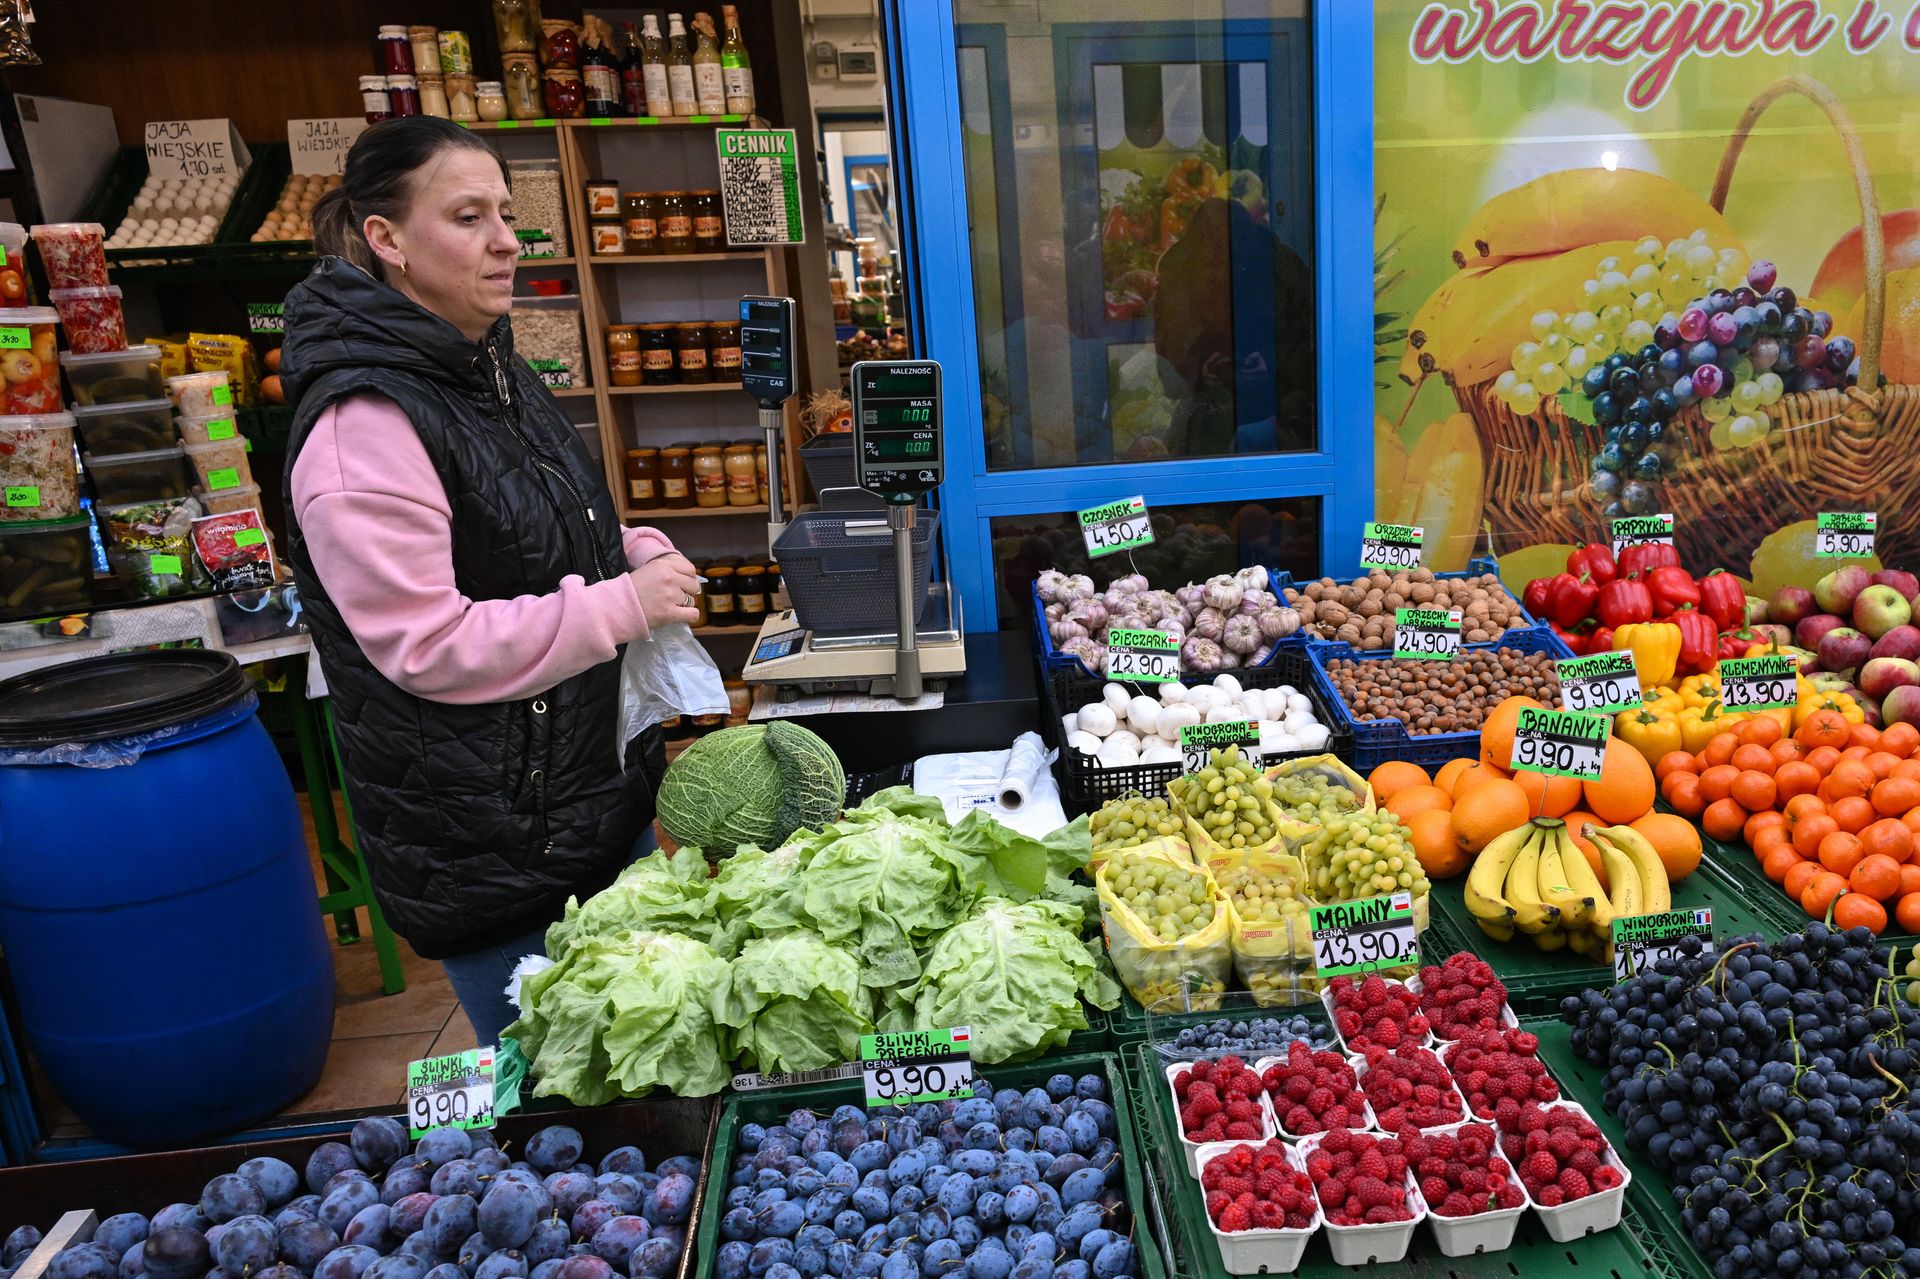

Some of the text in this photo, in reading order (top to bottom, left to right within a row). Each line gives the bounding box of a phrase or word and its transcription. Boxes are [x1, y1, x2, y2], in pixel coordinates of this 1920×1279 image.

[1409, 0, 1838, 111] warzywa
[148, 122, 192, 139] JAJA
[305, 121, 339, 137] JAJA
[146, 142, 224, 160] WIEJSKIE
[298, 137, 351, 152] WIEJSKIE
[726, 135, 787, 154] CENNIK
[769, 379, 784, 387] CAS
[913, 432, 933, 440] CENA
[1082, 503, 1132, 523] CZOSNEK
[1830, 513, 1862, 523] JABŁKA
[1093, 522, 1134, 548] 4.50
[1374, 524, 1415, 538] ORZECHY
[1614, 518, 1666, 535] PAPRYKA
[1824, 535, 1860, 554] 5.90
[1364, 544, 1411, 567] 29.90
[1407, 609, 1449, 621] ORZECHY
[1399, 631, 1448, 654] 24.90
[1112, 654, 1163, 676] 12.90
[1562, 677, 1589, 687] CENA:
[1723, 677, 1749, 685] CENA:
[1570, 680, 1621, 712] 9.90
[1724, 681, 1785, 707] 13.90
[1522, 709, 1597, 739] BANANY
[1189, 731, 1253, 745] RODZYNKOWE
[1518, 729, 1548, 740] CNA:
[1183, 744, 1210, 752] CENA:
[1519, 738, 1574, 771] 9.90
[1315, 927, 1349, 939] CENA:
[1320, 932, 1400, 968] 13.90
[875, 1042, 951, 1061] PRECENTA
[865, 1059, 900, 1069] CENA:
[412, 1074, 430, 1087] TOP
[875, 1066, 946, 1099] 9.90
[412, 1084, 439, 1097] CENA:
[415, 1090, 468, 1131] 9.90
